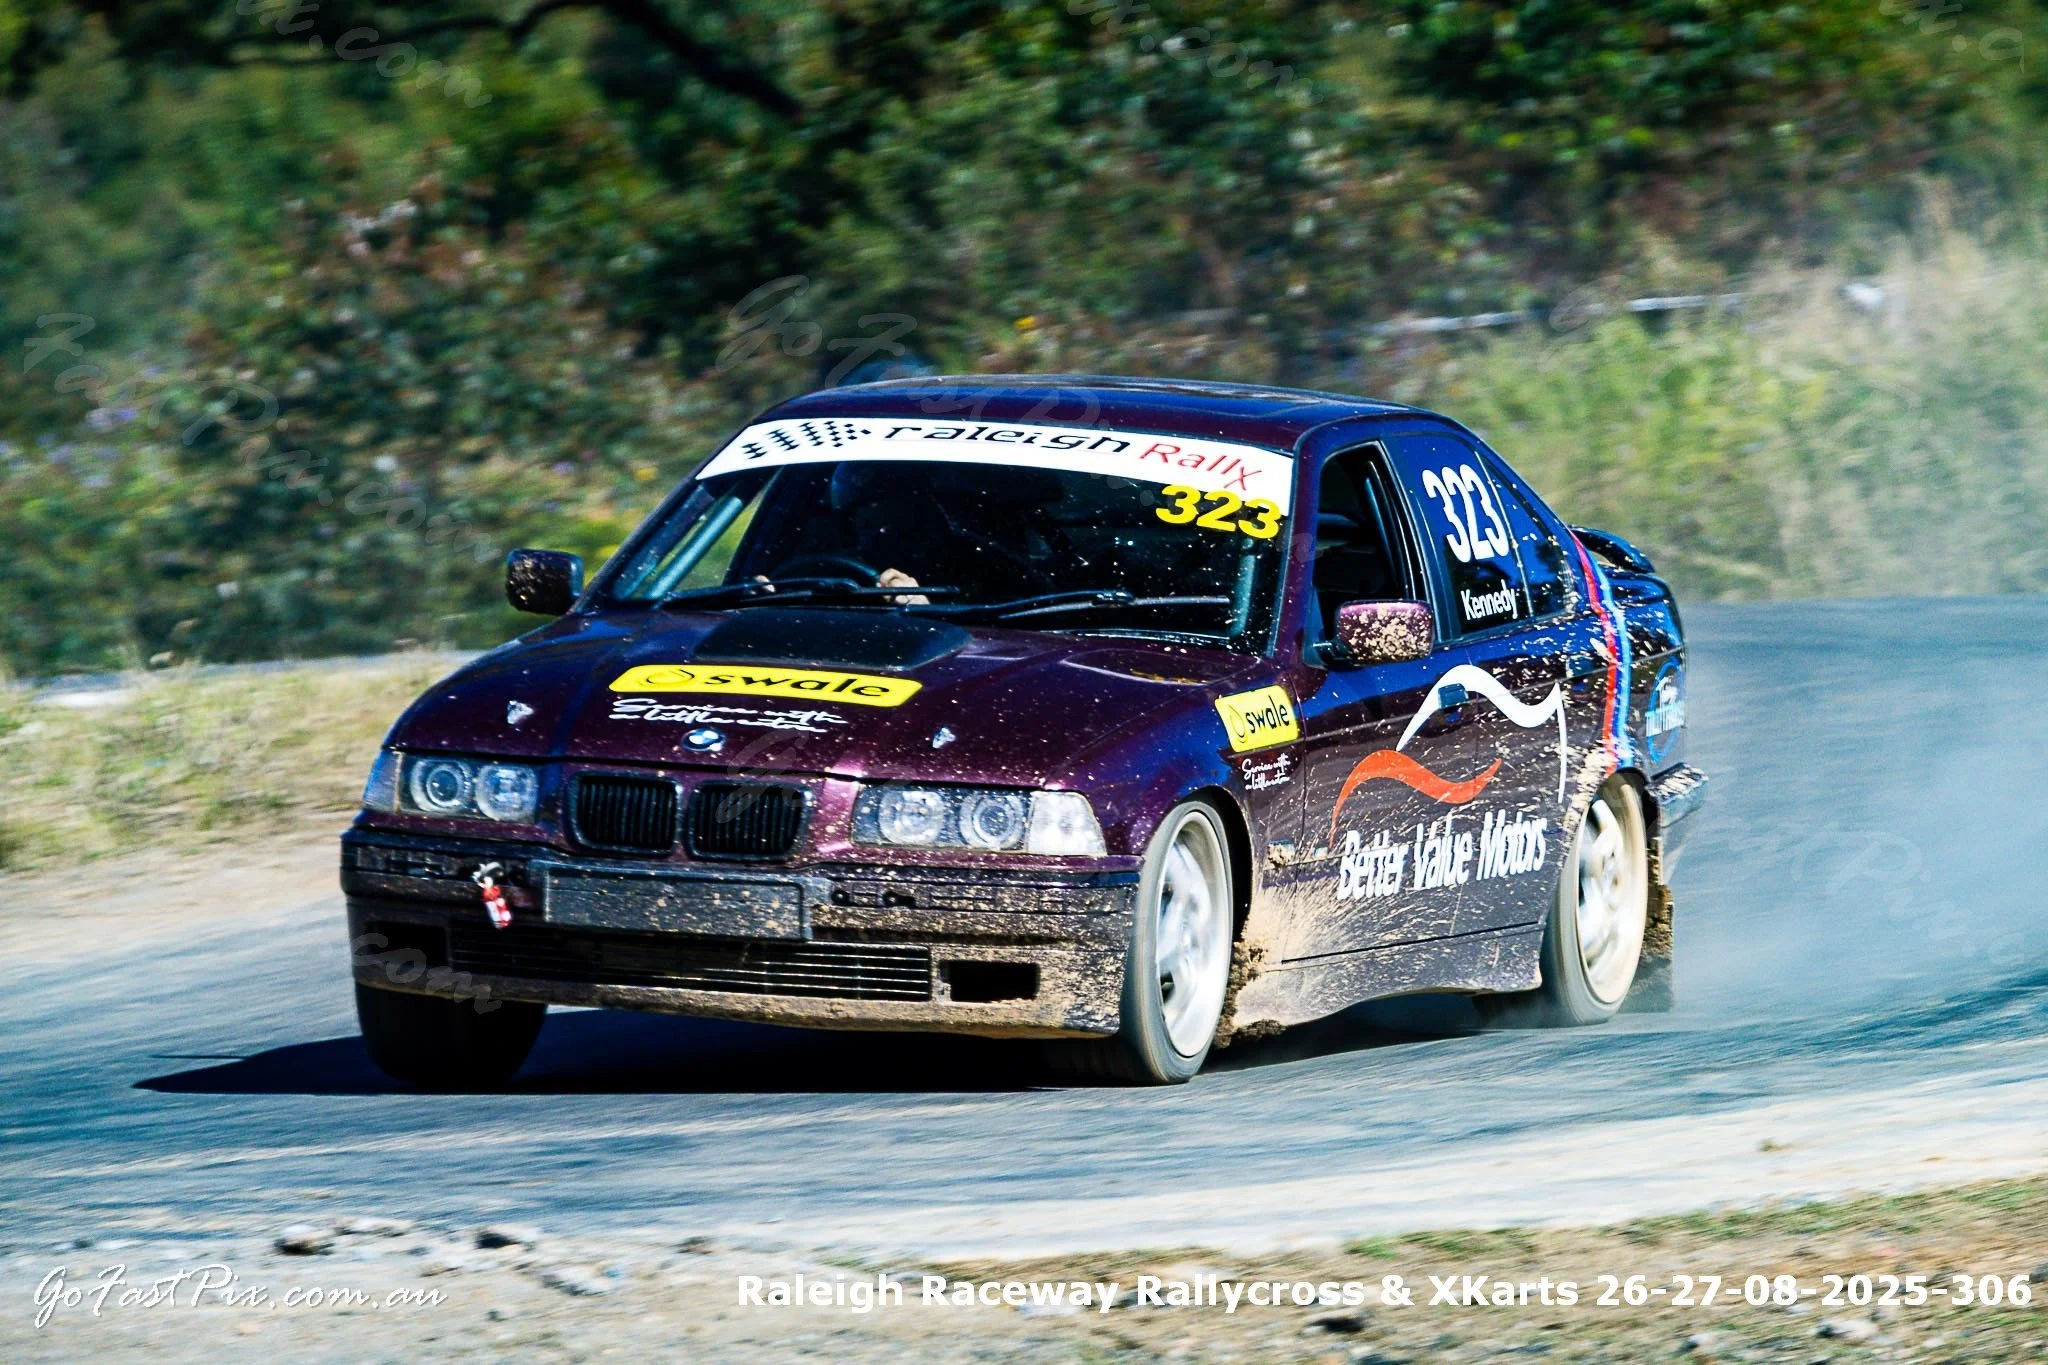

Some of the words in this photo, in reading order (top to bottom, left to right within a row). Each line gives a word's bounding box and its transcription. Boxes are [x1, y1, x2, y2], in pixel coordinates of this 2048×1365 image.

[885, 424, 1132, 454] raleigh
[1155, 484, 1282, 539] 323
[1422, 464, 1510, 563] 323
[1460, 578, 1519, 620] Kennedy
[703, 671, 891, 698] swale
[1244, 694, 1290, 735] swale
[1336, 829, 1410, 901] Better
[1412, 810, 1473, 891] Value
[1475, 808, 1548, 881] Motors
